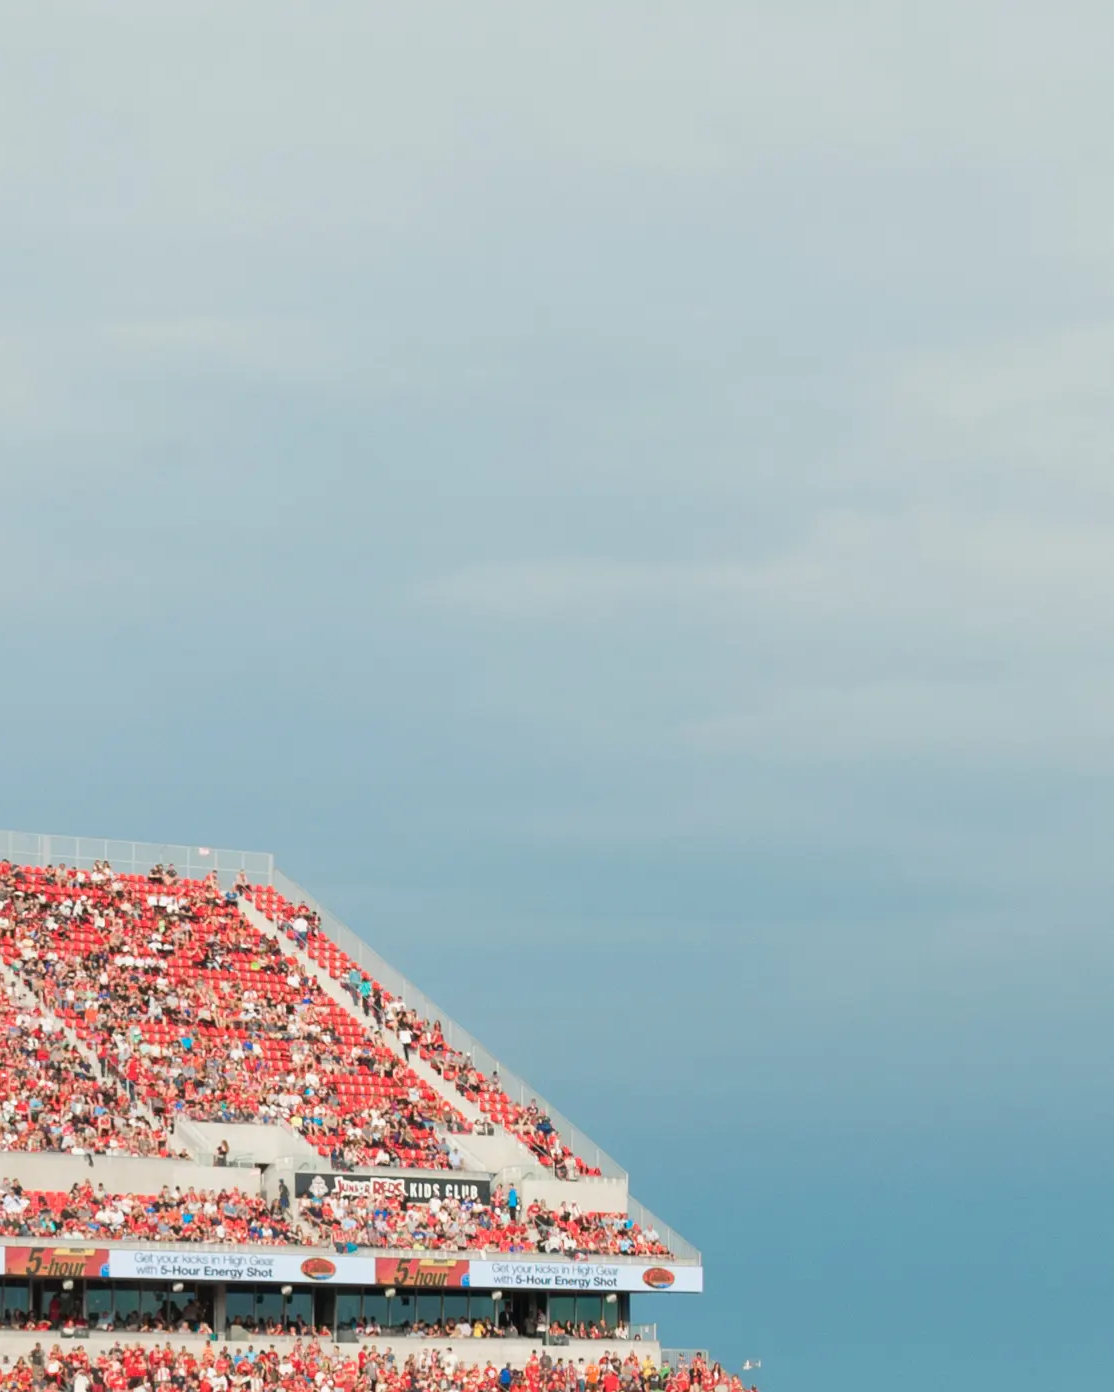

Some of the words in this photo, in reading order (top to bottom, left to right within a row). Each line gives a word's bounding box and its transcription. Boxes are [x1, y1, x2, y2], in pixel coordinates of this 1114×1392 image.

[410, 1183, 441, 1198] KIDS
[446, 1184, 478, 1199] CLUB
[26, 1248, 85, 1277] 5-hour
[134, 1252, 155, 1263] Get
[158, 1255, 180, 1266] your
[182, 1253, 208, 1264] kicks
[211, 1254, 218, 1264] in
[222, 1254, 246, 1267] High
[248, 1255, 273, 1266] Gear
[136, 1265, 158, 1275] with
[161, 1265, 200, 1276] 5-Hour
[204, 1265, 243, 1279] Energy
[247, 1267, 272, 1278] Shot
[493, 1275, 513, 1284] with
[516, 1275, 551, 1287] 5-Hour
[555, 1276, 591, 1289] Energy
[594, 1277, 617, 1287] Shot
